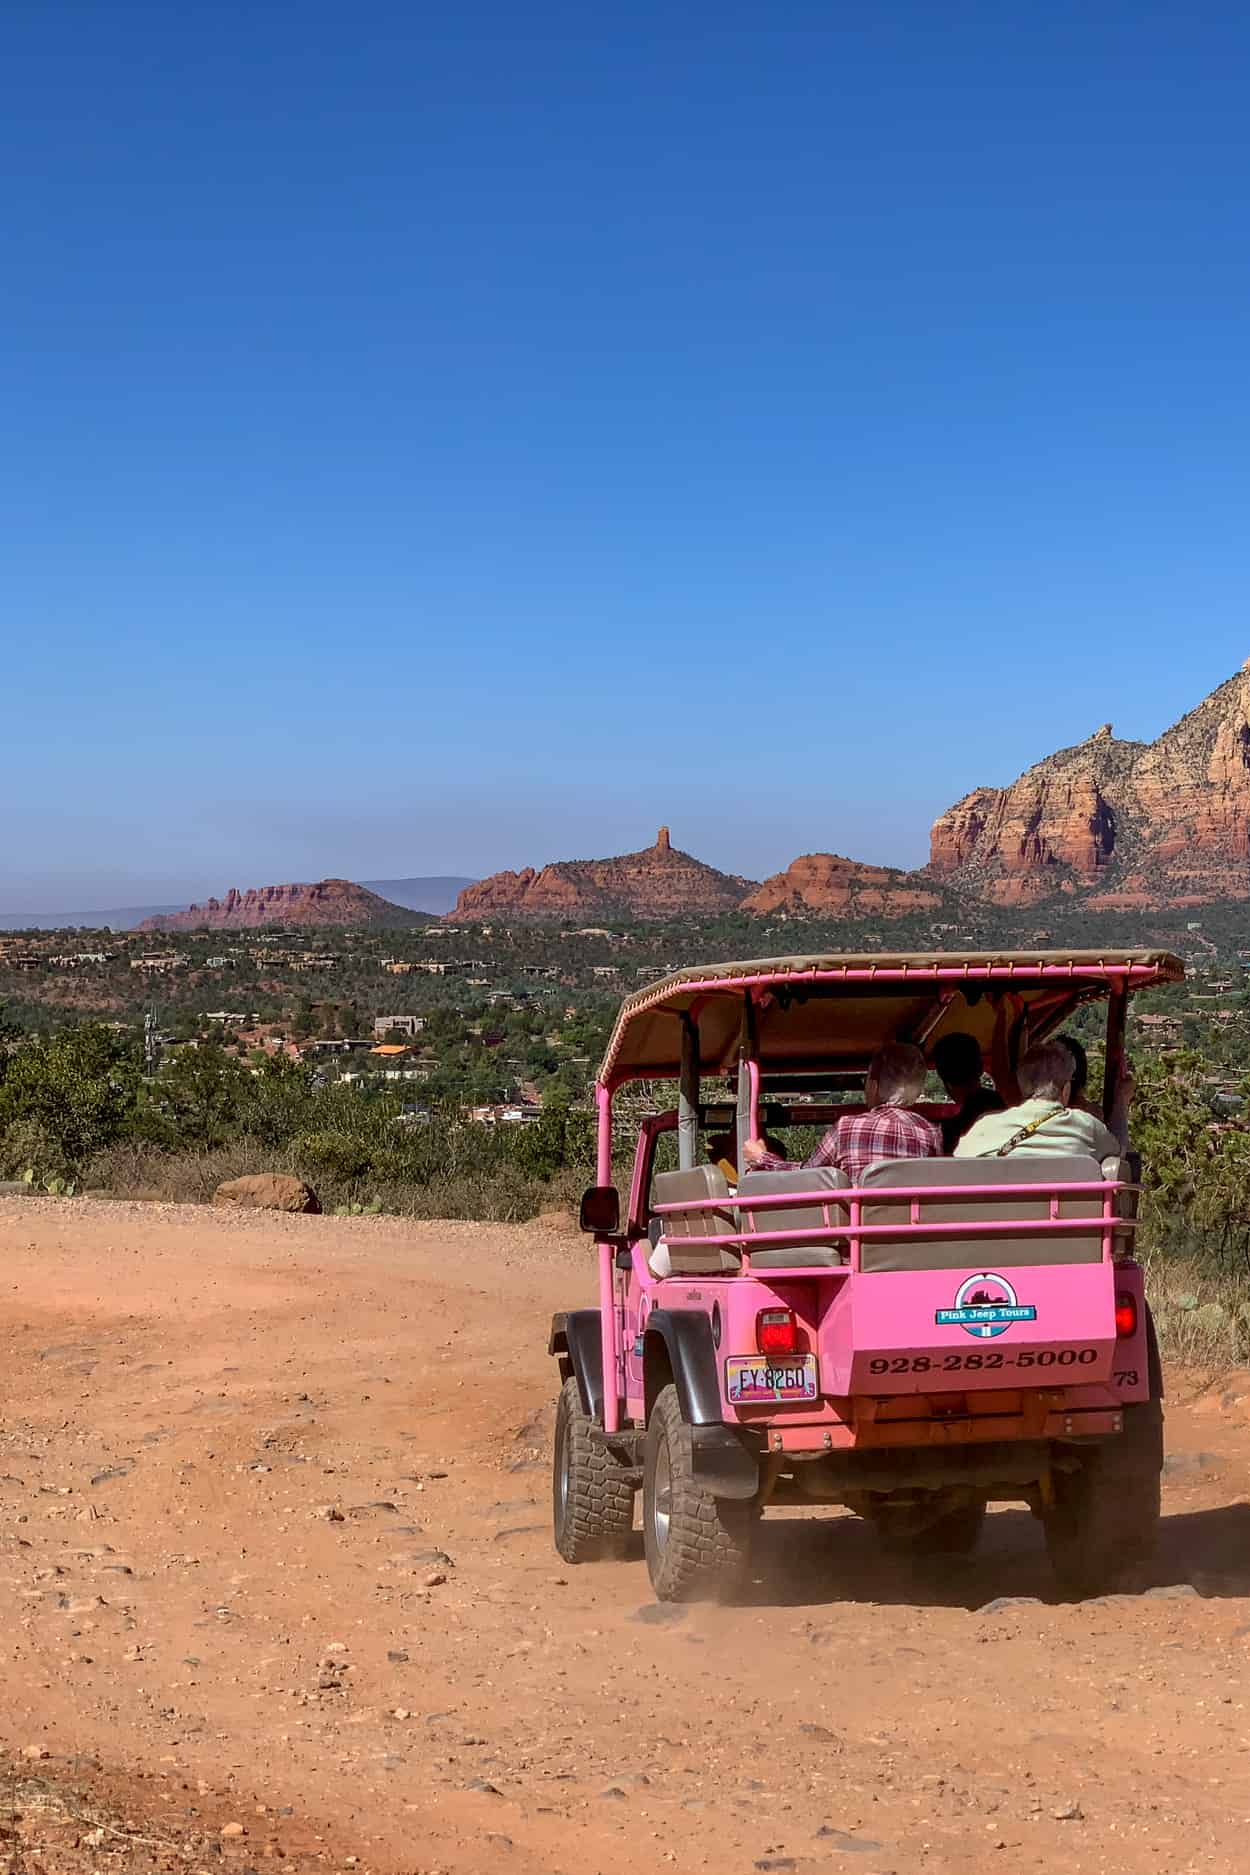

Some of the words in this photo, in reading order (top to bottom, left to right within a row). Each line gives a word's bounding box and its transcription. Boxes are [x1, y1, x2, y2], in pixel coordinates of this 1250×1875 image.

[940, 1310, 967, 1321] Pink
[969, 1310, 996, 1321] Jeep
[999, 1308, 1030, 1318] Tours
[869, 1348, 1098, 1375] 928-282-5000
[1113, 1370, 1139, 1387] 73
